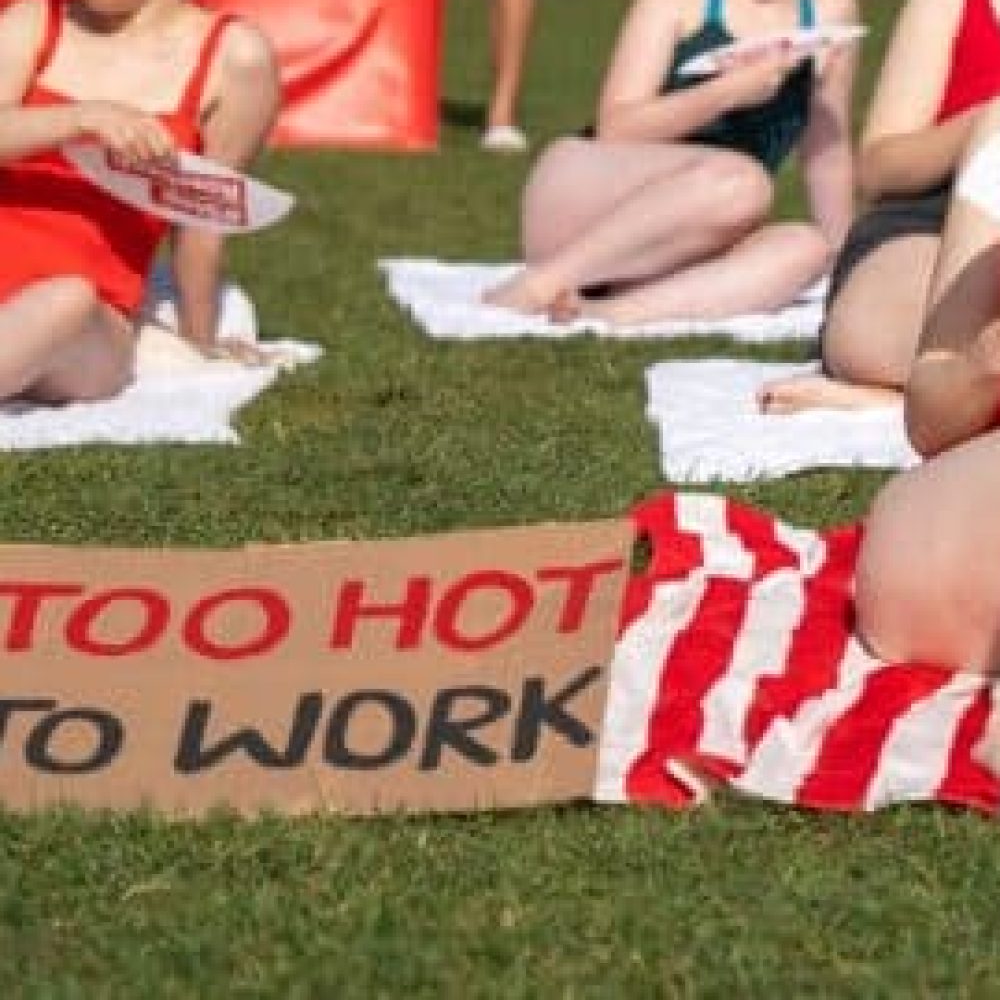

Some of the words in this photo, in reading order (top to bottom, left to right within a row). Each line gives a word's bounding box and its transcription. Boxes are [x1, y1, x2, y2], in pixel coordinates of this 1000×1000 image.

[0, 580, 292, 660] TOO
[329, 558, 624, 653] HOT
[173, 665, 602, 775] WORK
